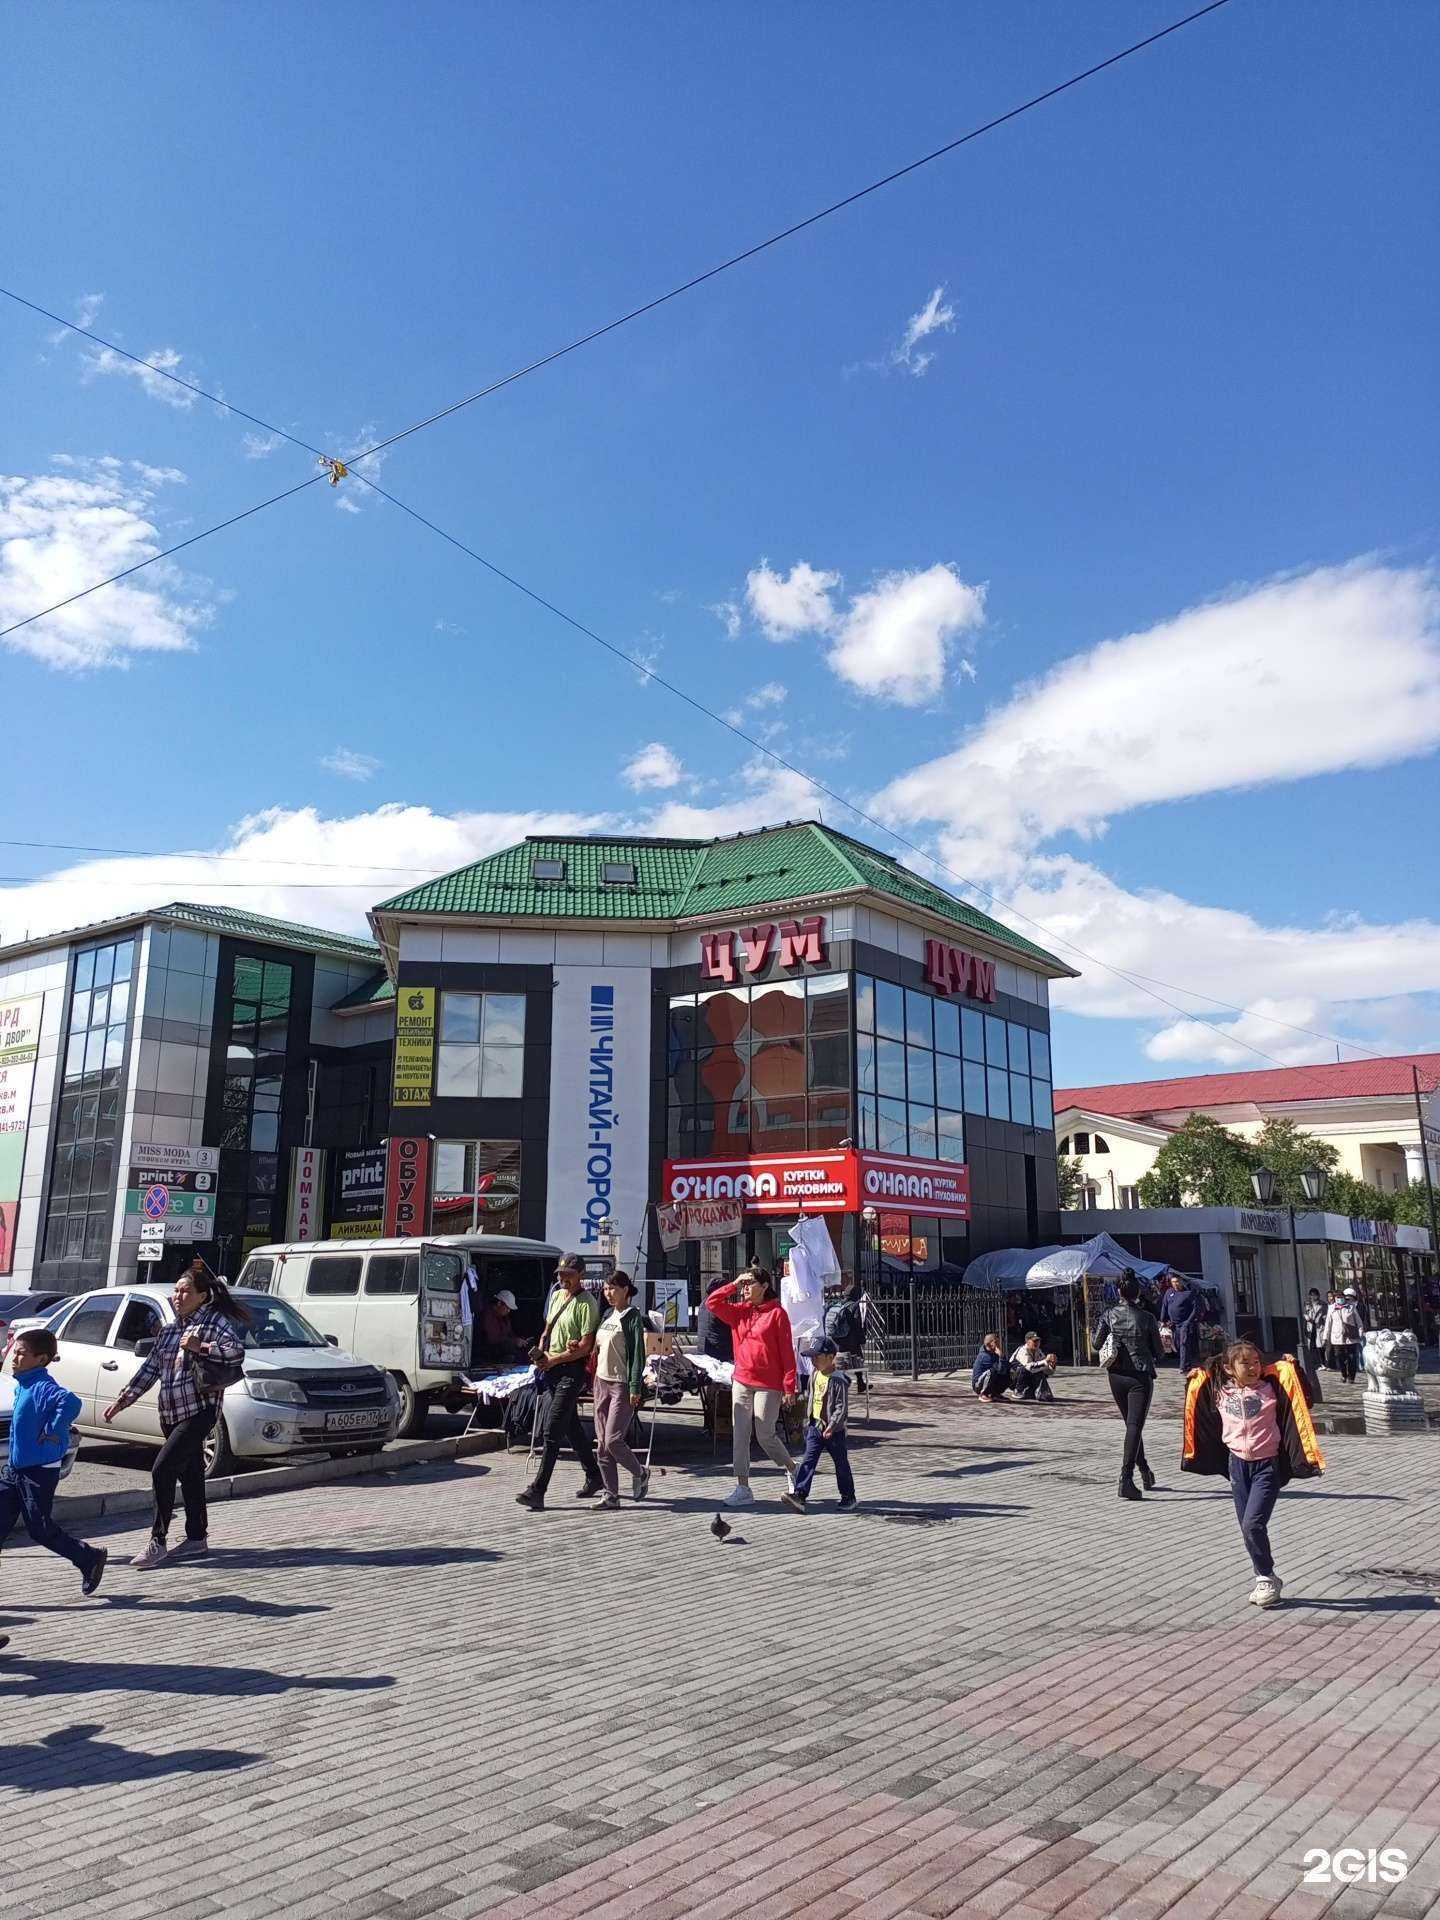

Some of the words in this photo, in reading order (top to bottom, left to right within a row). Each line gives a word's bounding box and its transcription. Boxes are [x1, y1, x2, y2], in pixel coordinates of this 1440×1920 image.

[701, 916, 826, 982] ЦУМ
[926, 939, 996, 1003] ЦУМ
[399, 1017, 432, 1027] РЕМОНТ
[399, 1038, 432, 1047] ТЕХНИКИ
[402, 1088, 430, 1100] ЭТАЖ
[580, 1036, 619, 1243] ЧИТАЙ-ГОРОД
[138, 1146, 161, 1156] MISS
[164, 1149, 191, 1158] MODA
[202, 1152, 208, 1161] 3
[139, 1170, 174, 1183] print
[342, 1161, 383, 1190] print
[671, 1173, 777, 1200] O'HARA
[783, 1170, 826, 1182] КУРТКИ
[783, 1183, 844, 1196] ПУХОВИКИ
[864, 1169, 933, 1198] O'HARA
[934, 1177, 957, 1189] КУРТКИ
[935, 1191, 967, 1203] ПУХОВИКИ
